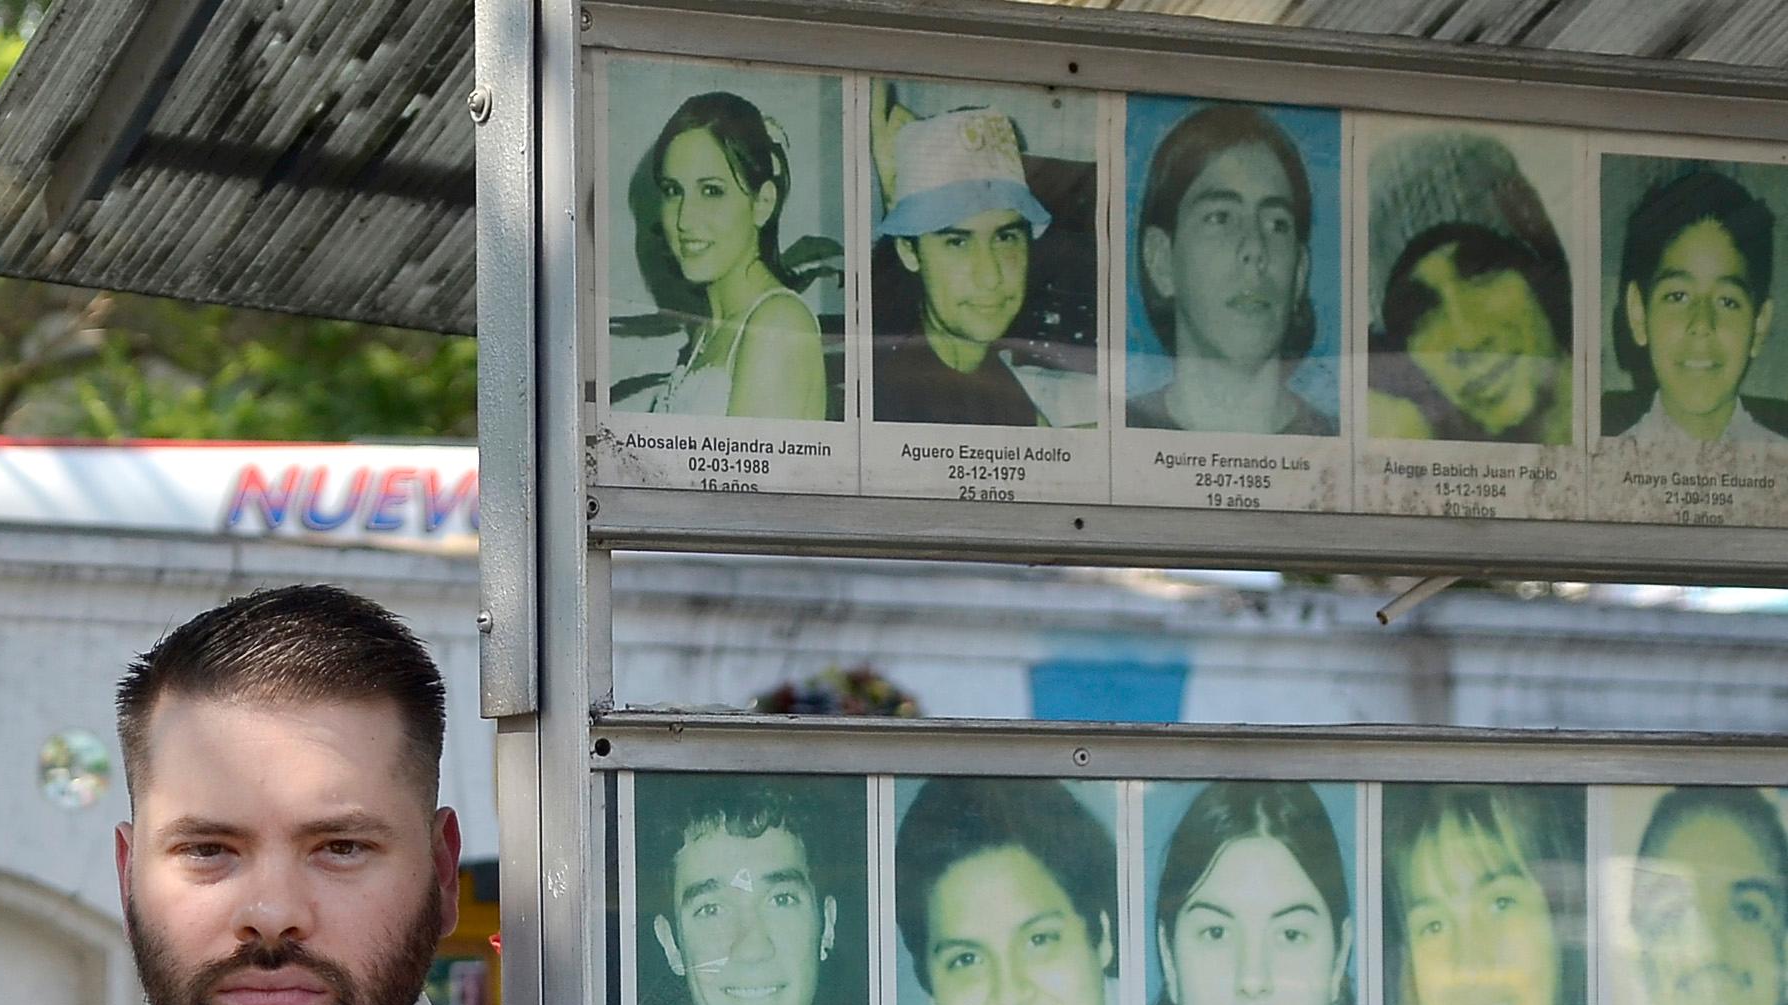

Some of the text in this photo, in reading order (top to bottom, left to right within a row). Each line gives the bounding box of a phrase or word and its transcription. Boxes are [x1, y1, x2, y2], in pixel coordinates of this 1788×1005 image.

[625, 433, 831, 456] Abosaleh Alejandra Jazmin
[901, 443, 1071, 463] Aguero Ezequiel Adolfo
[1154, 451, 1310, 471] Aguirre Fernando Luis
[688, 457, 770, 474] 02-03-1988
[948, 465, 1026, 481] 28-12-1979
[1432, 462, 1478, 478] Babich
[1483, 465, 1515, 479] Juan
[1519, 466, 1557, 480] Pablo
[700, 478, 758, 492] 16 años
[1195, 473, 1271, 489] 28-07-1985
[1623, 471, 1775, 488] Amaya Gaston Eduardo
[225, 464, 479, 531] NUEV
[959, 486, 1015, 501] 25 años
[1207, 494, 1261, 508] 19 años
[1464, 504, 1496, 517] años
[1693, 510, 1724, 525] años
